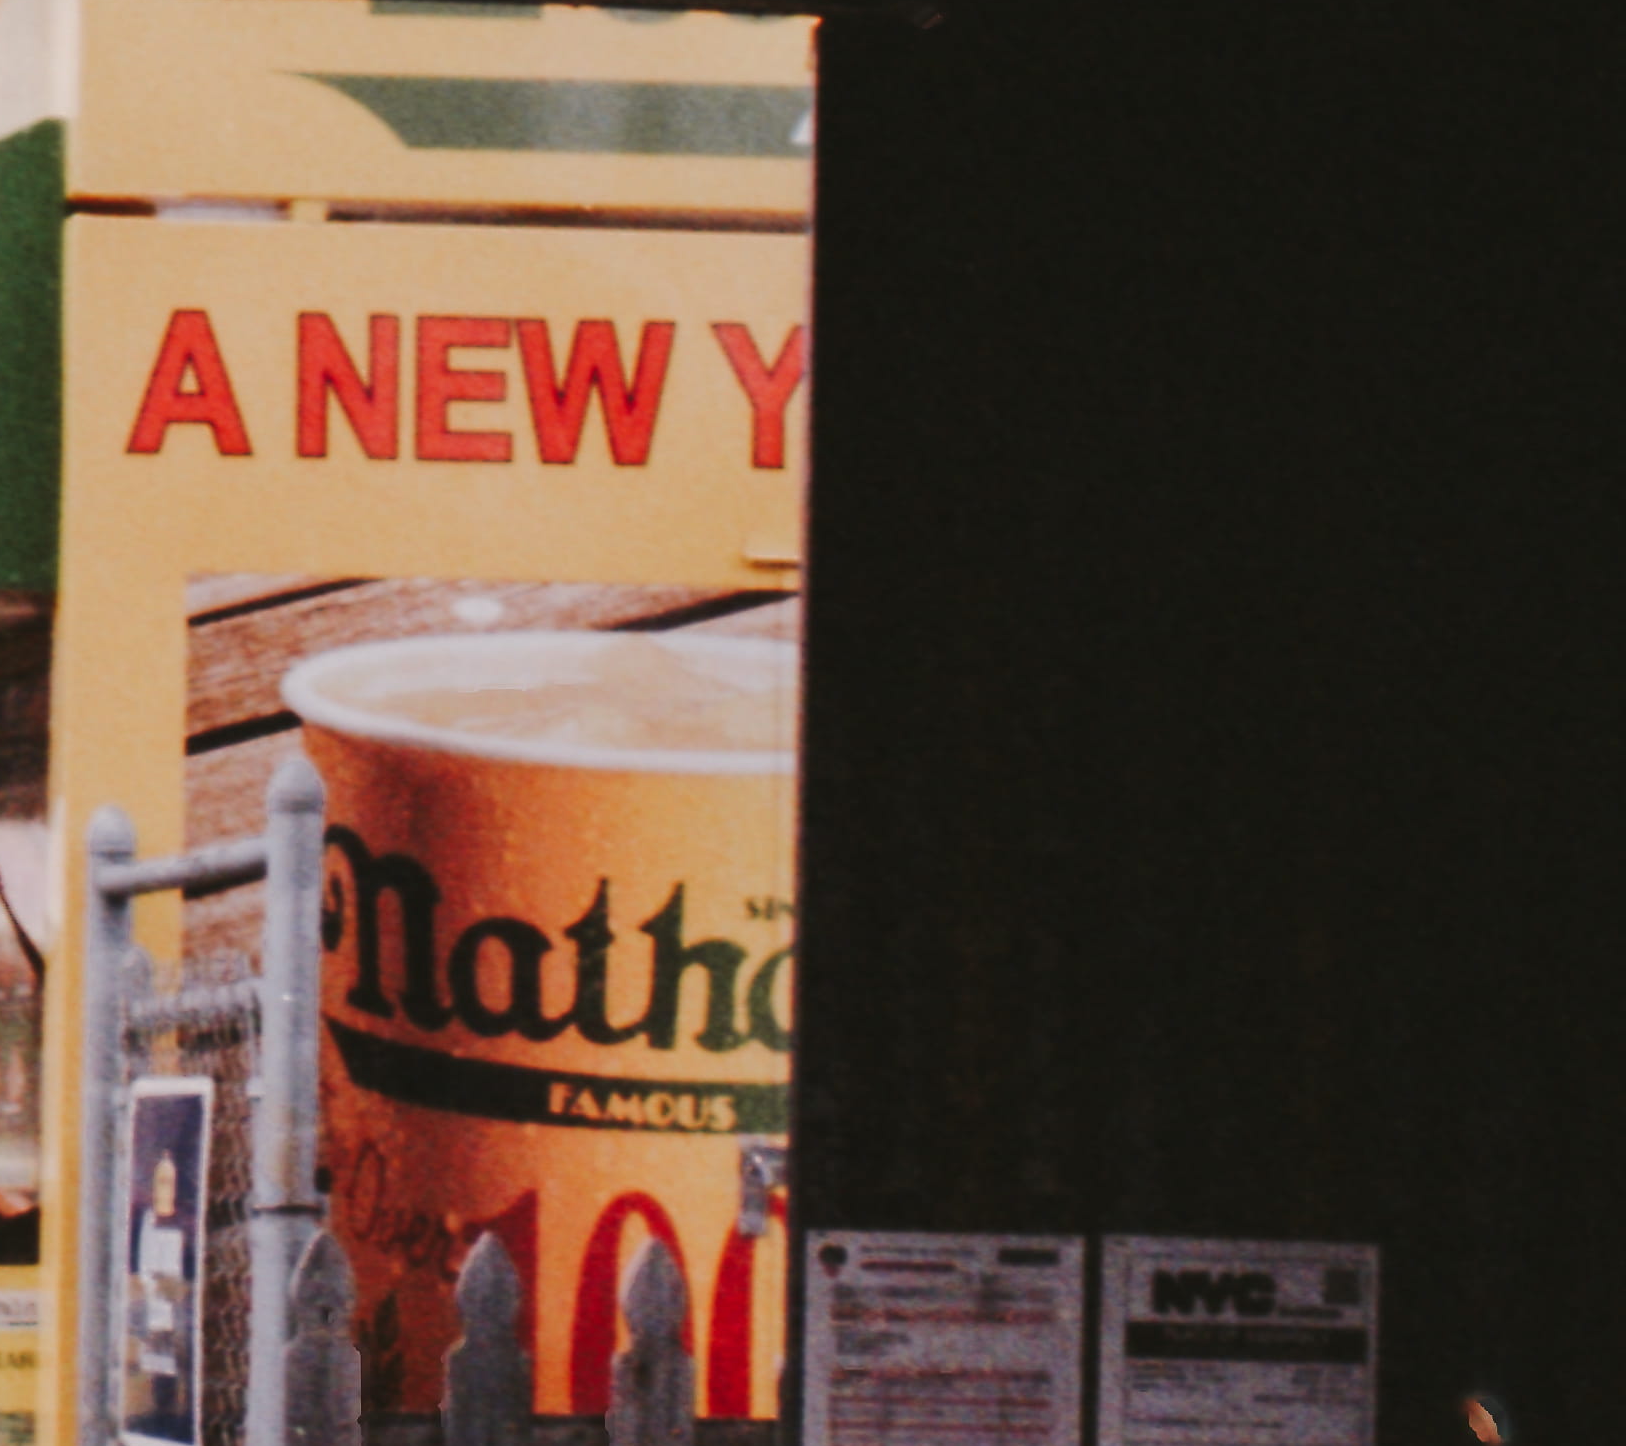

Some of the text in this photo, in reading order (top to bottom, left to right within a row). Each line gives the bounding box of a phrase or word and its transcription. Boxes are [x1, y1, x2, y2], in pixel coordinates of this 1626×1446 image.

[126, 308, 252, 457] A
[296, 311, 676, 466] NEW
[548, 1081, 738, 1131] FAMOUS
[1153, 1269, 1277, 1316] NYC
